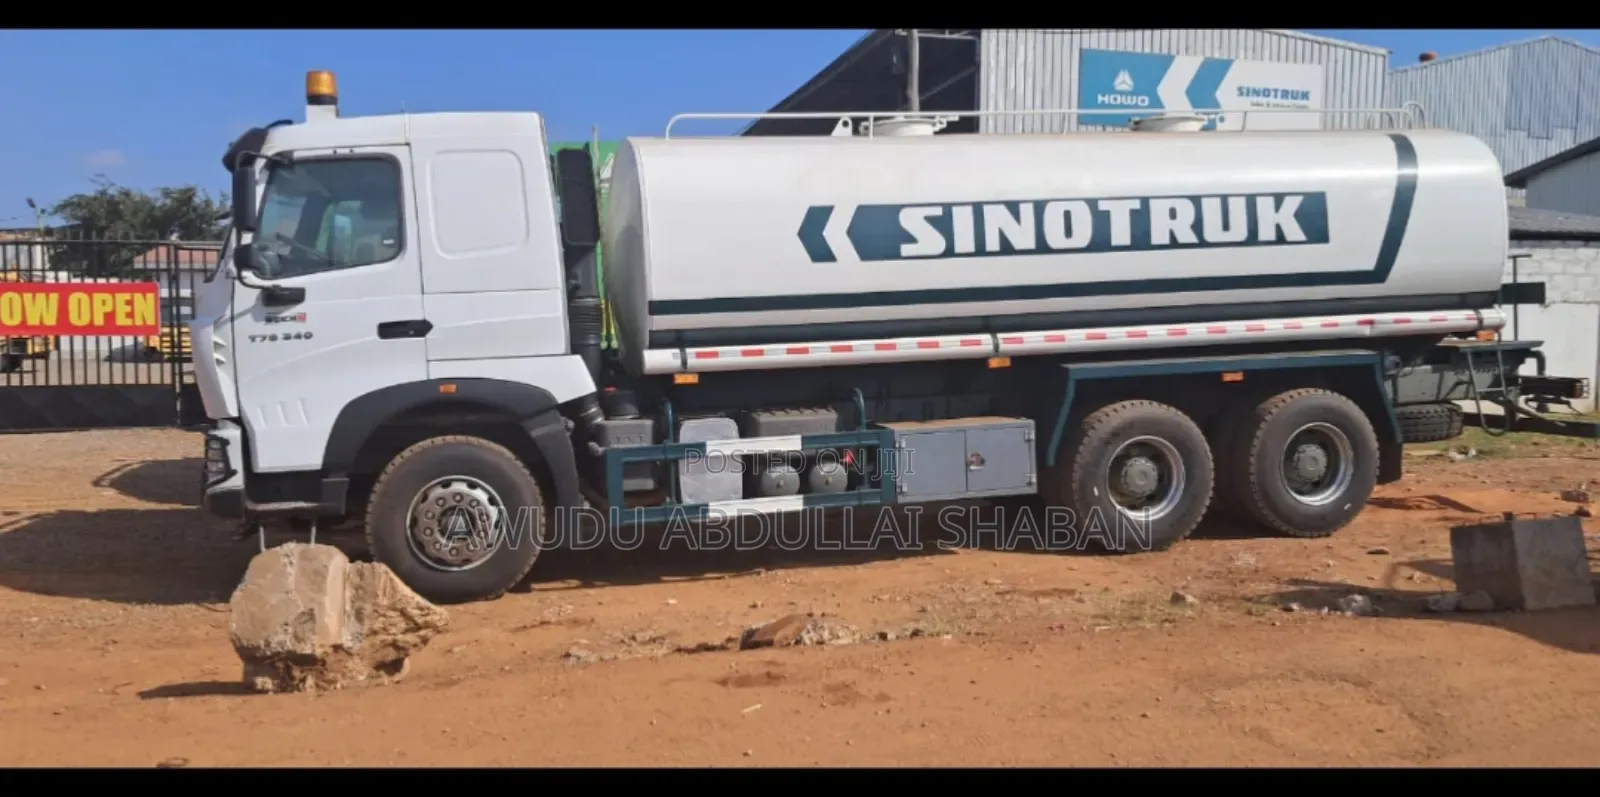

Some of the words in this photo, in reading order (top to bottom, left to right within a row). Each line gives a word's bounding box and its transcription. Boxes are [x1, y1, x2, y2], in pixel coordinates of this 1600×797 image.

[1097, 93, 1149, 107] HOWO
[1236, 86, 1310, 101] SINOTRUK
[898, 195, 1307, 258] SINOTRUK
[0, 291, 59, 326] OW
[68, 291, 156, 327] OPEN
